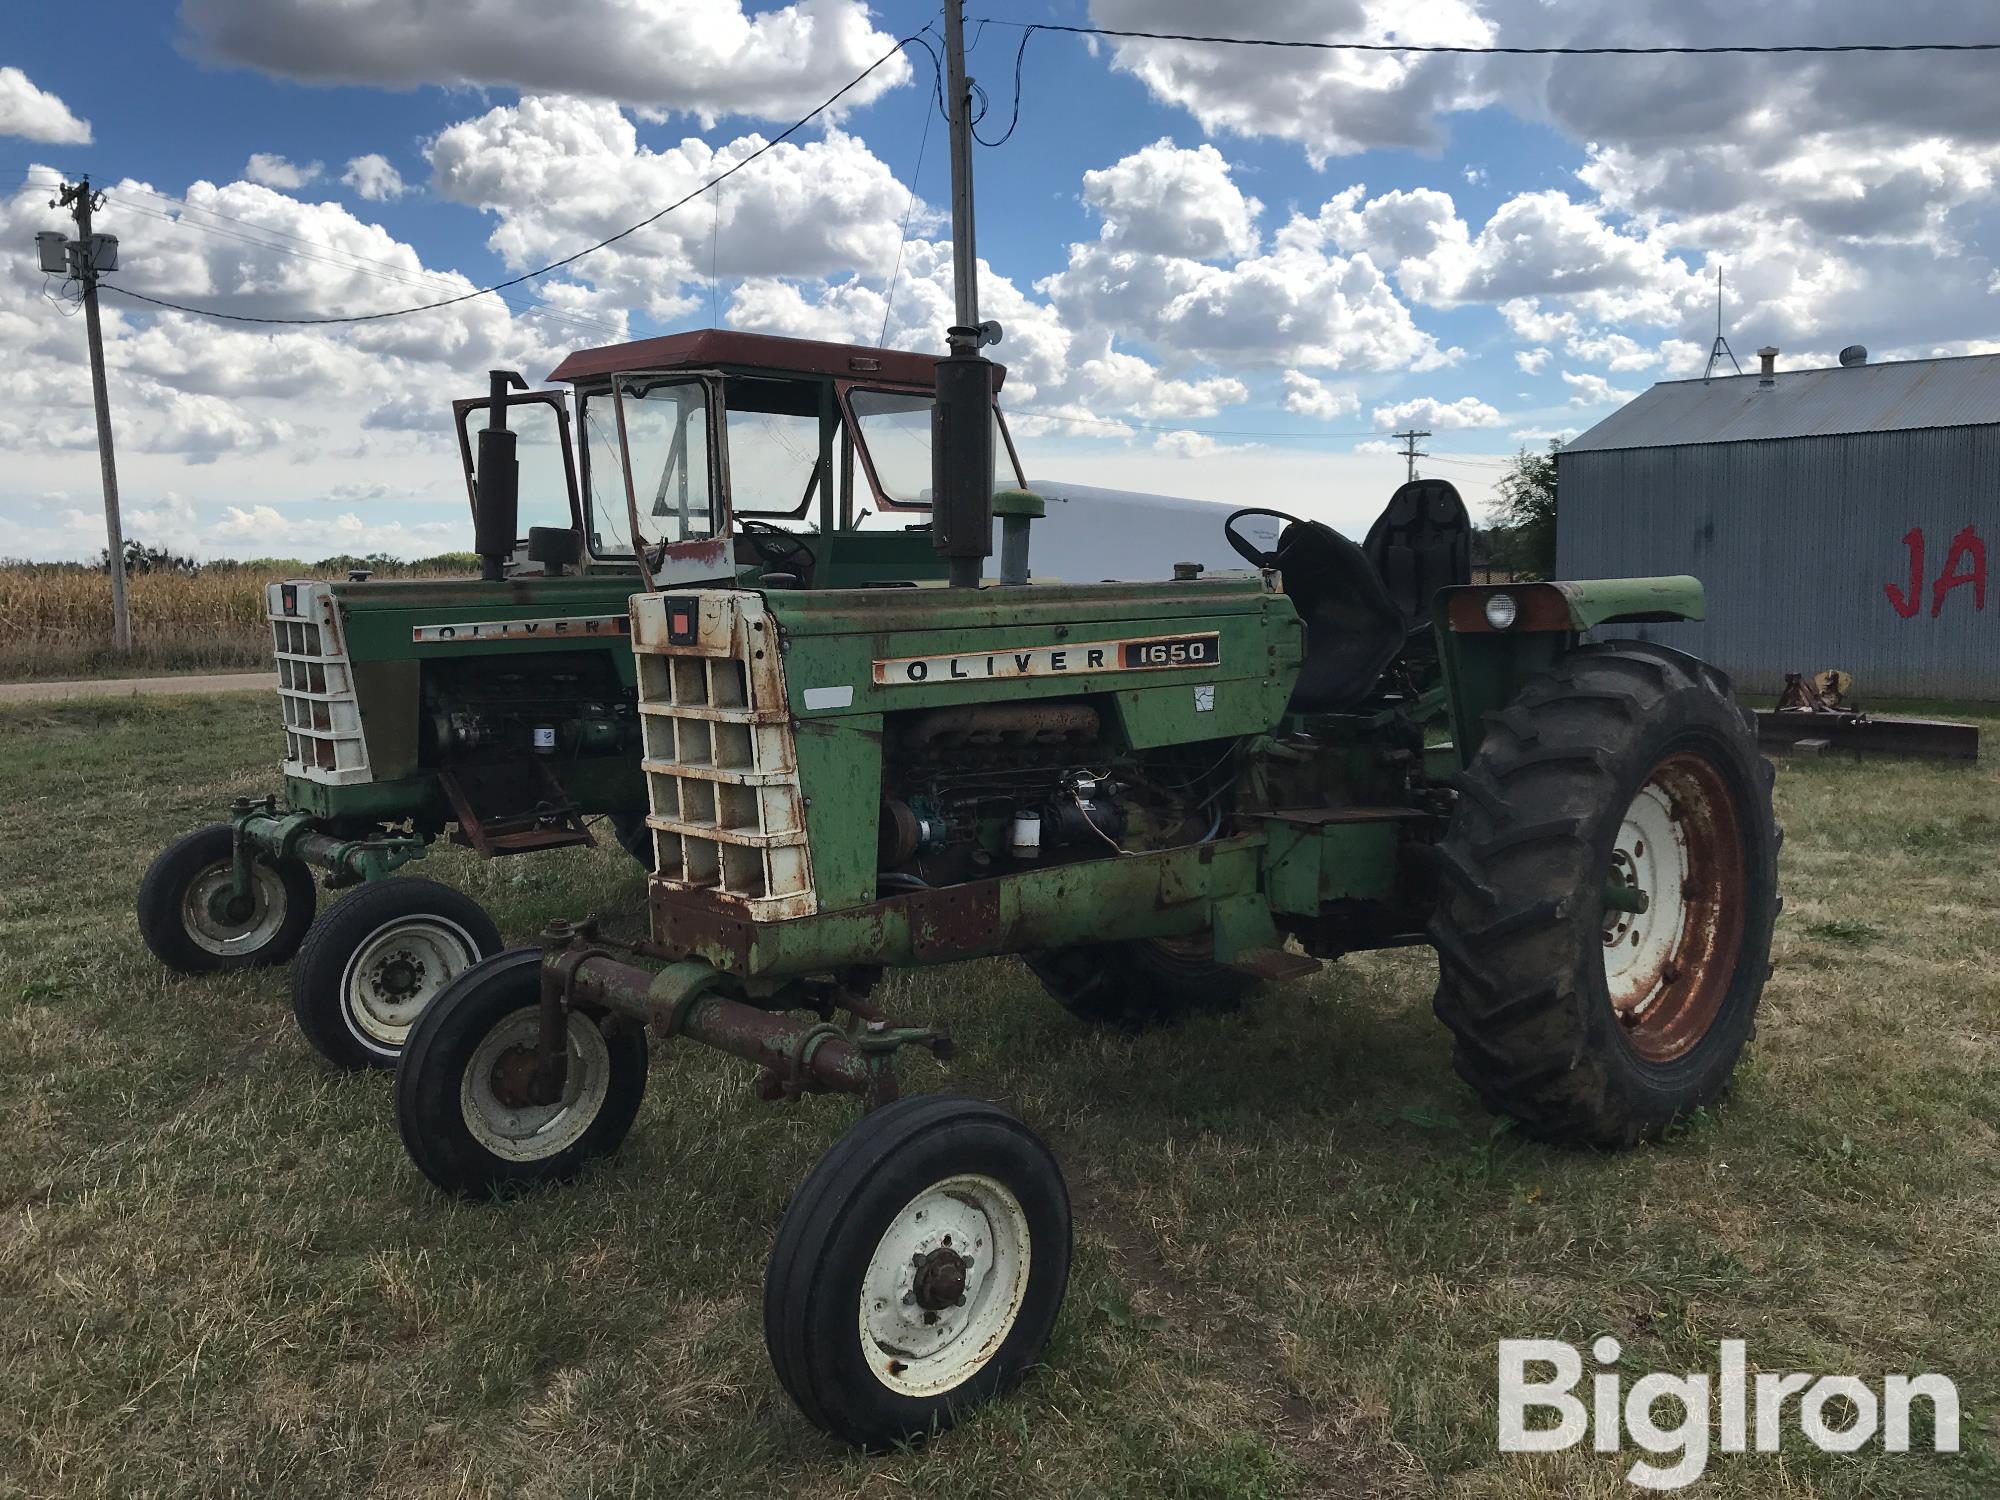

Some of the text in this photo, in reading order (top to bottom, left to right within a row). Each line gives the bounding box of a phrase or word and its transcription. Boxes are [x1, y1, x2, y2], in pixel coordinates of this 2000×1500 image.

[1884, 524, 1985, 618] JA
[438, 621, 600, 639] OLIVER
[907, 643, 1205, 681] OLIVER 1650
